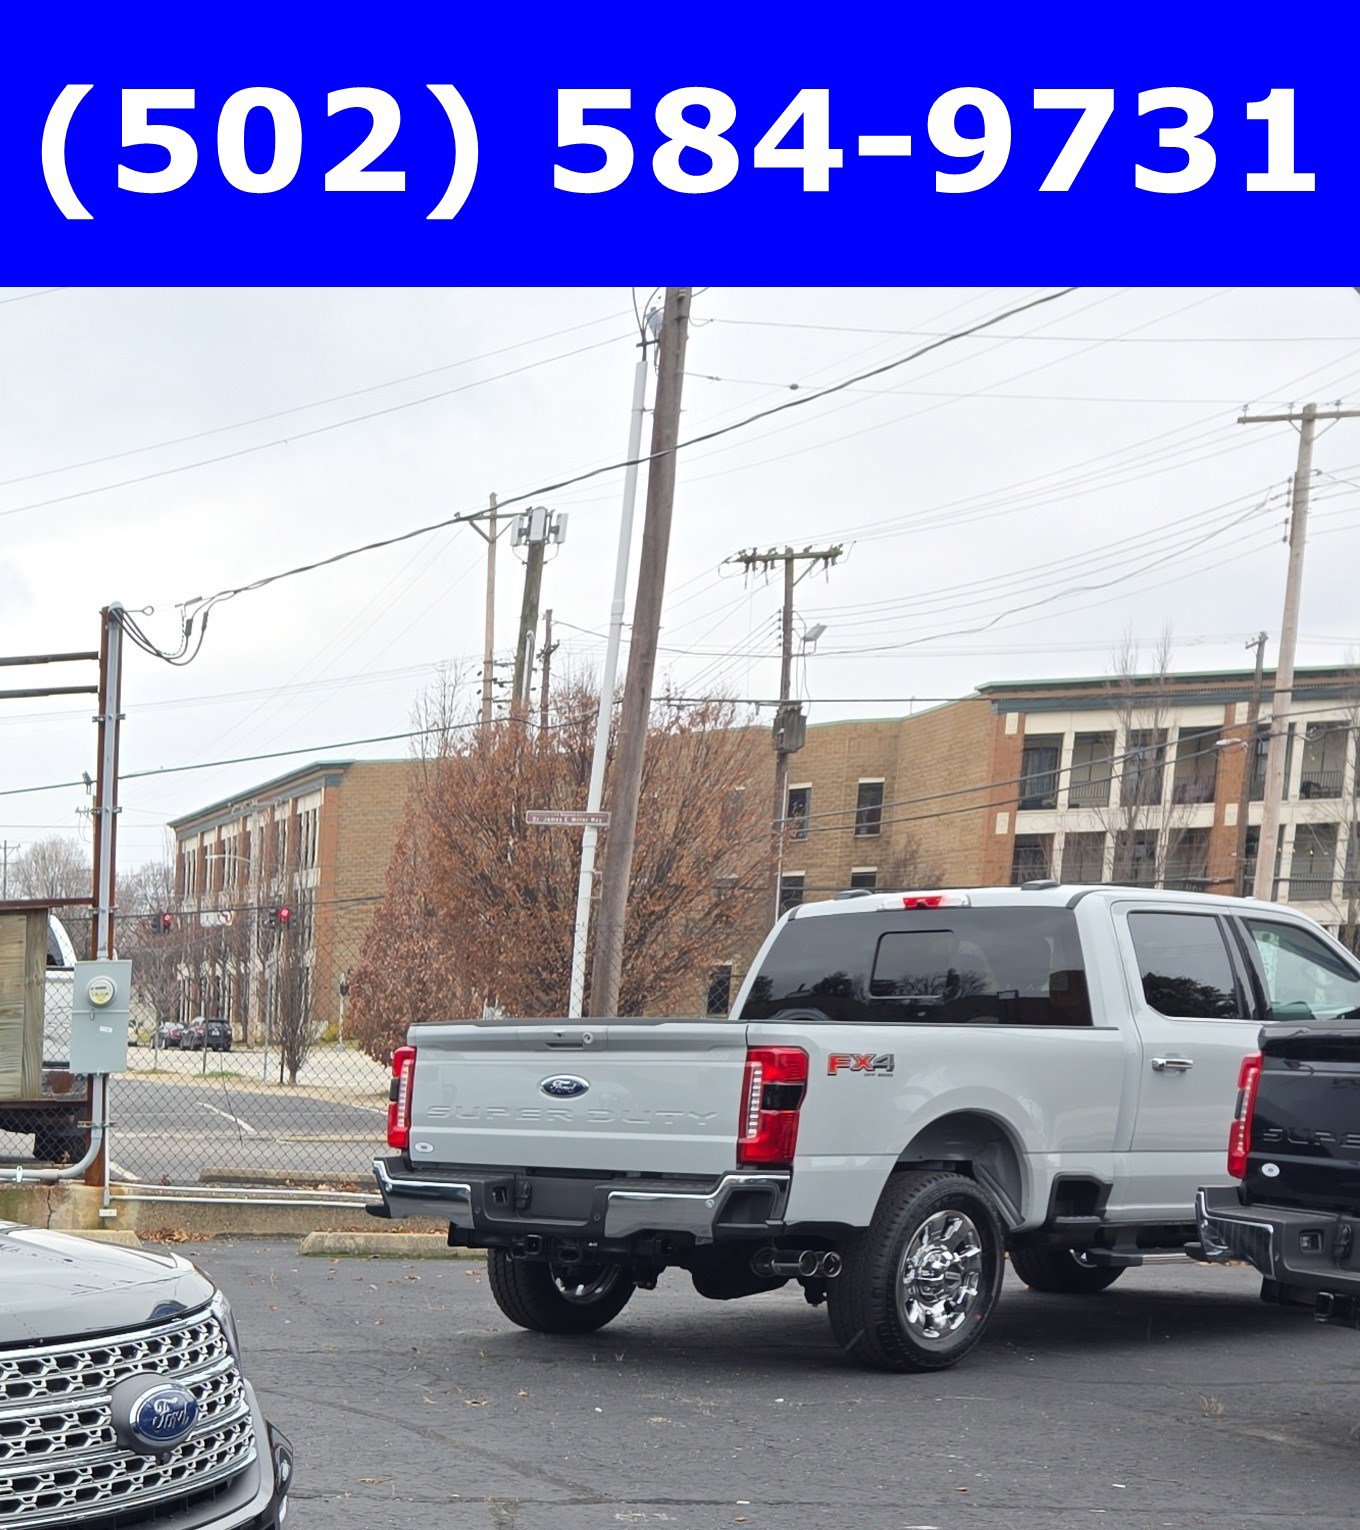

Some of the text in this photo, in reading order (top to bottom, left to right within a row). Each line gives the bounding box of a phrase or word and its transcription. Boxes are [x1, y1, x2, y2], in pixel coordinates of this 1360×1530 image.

[827, 1053, 895, 1076] FX4
[427, 1105, 718, 1126] SUPER DUTY
[151, 1396, 190, 1434] Ford
